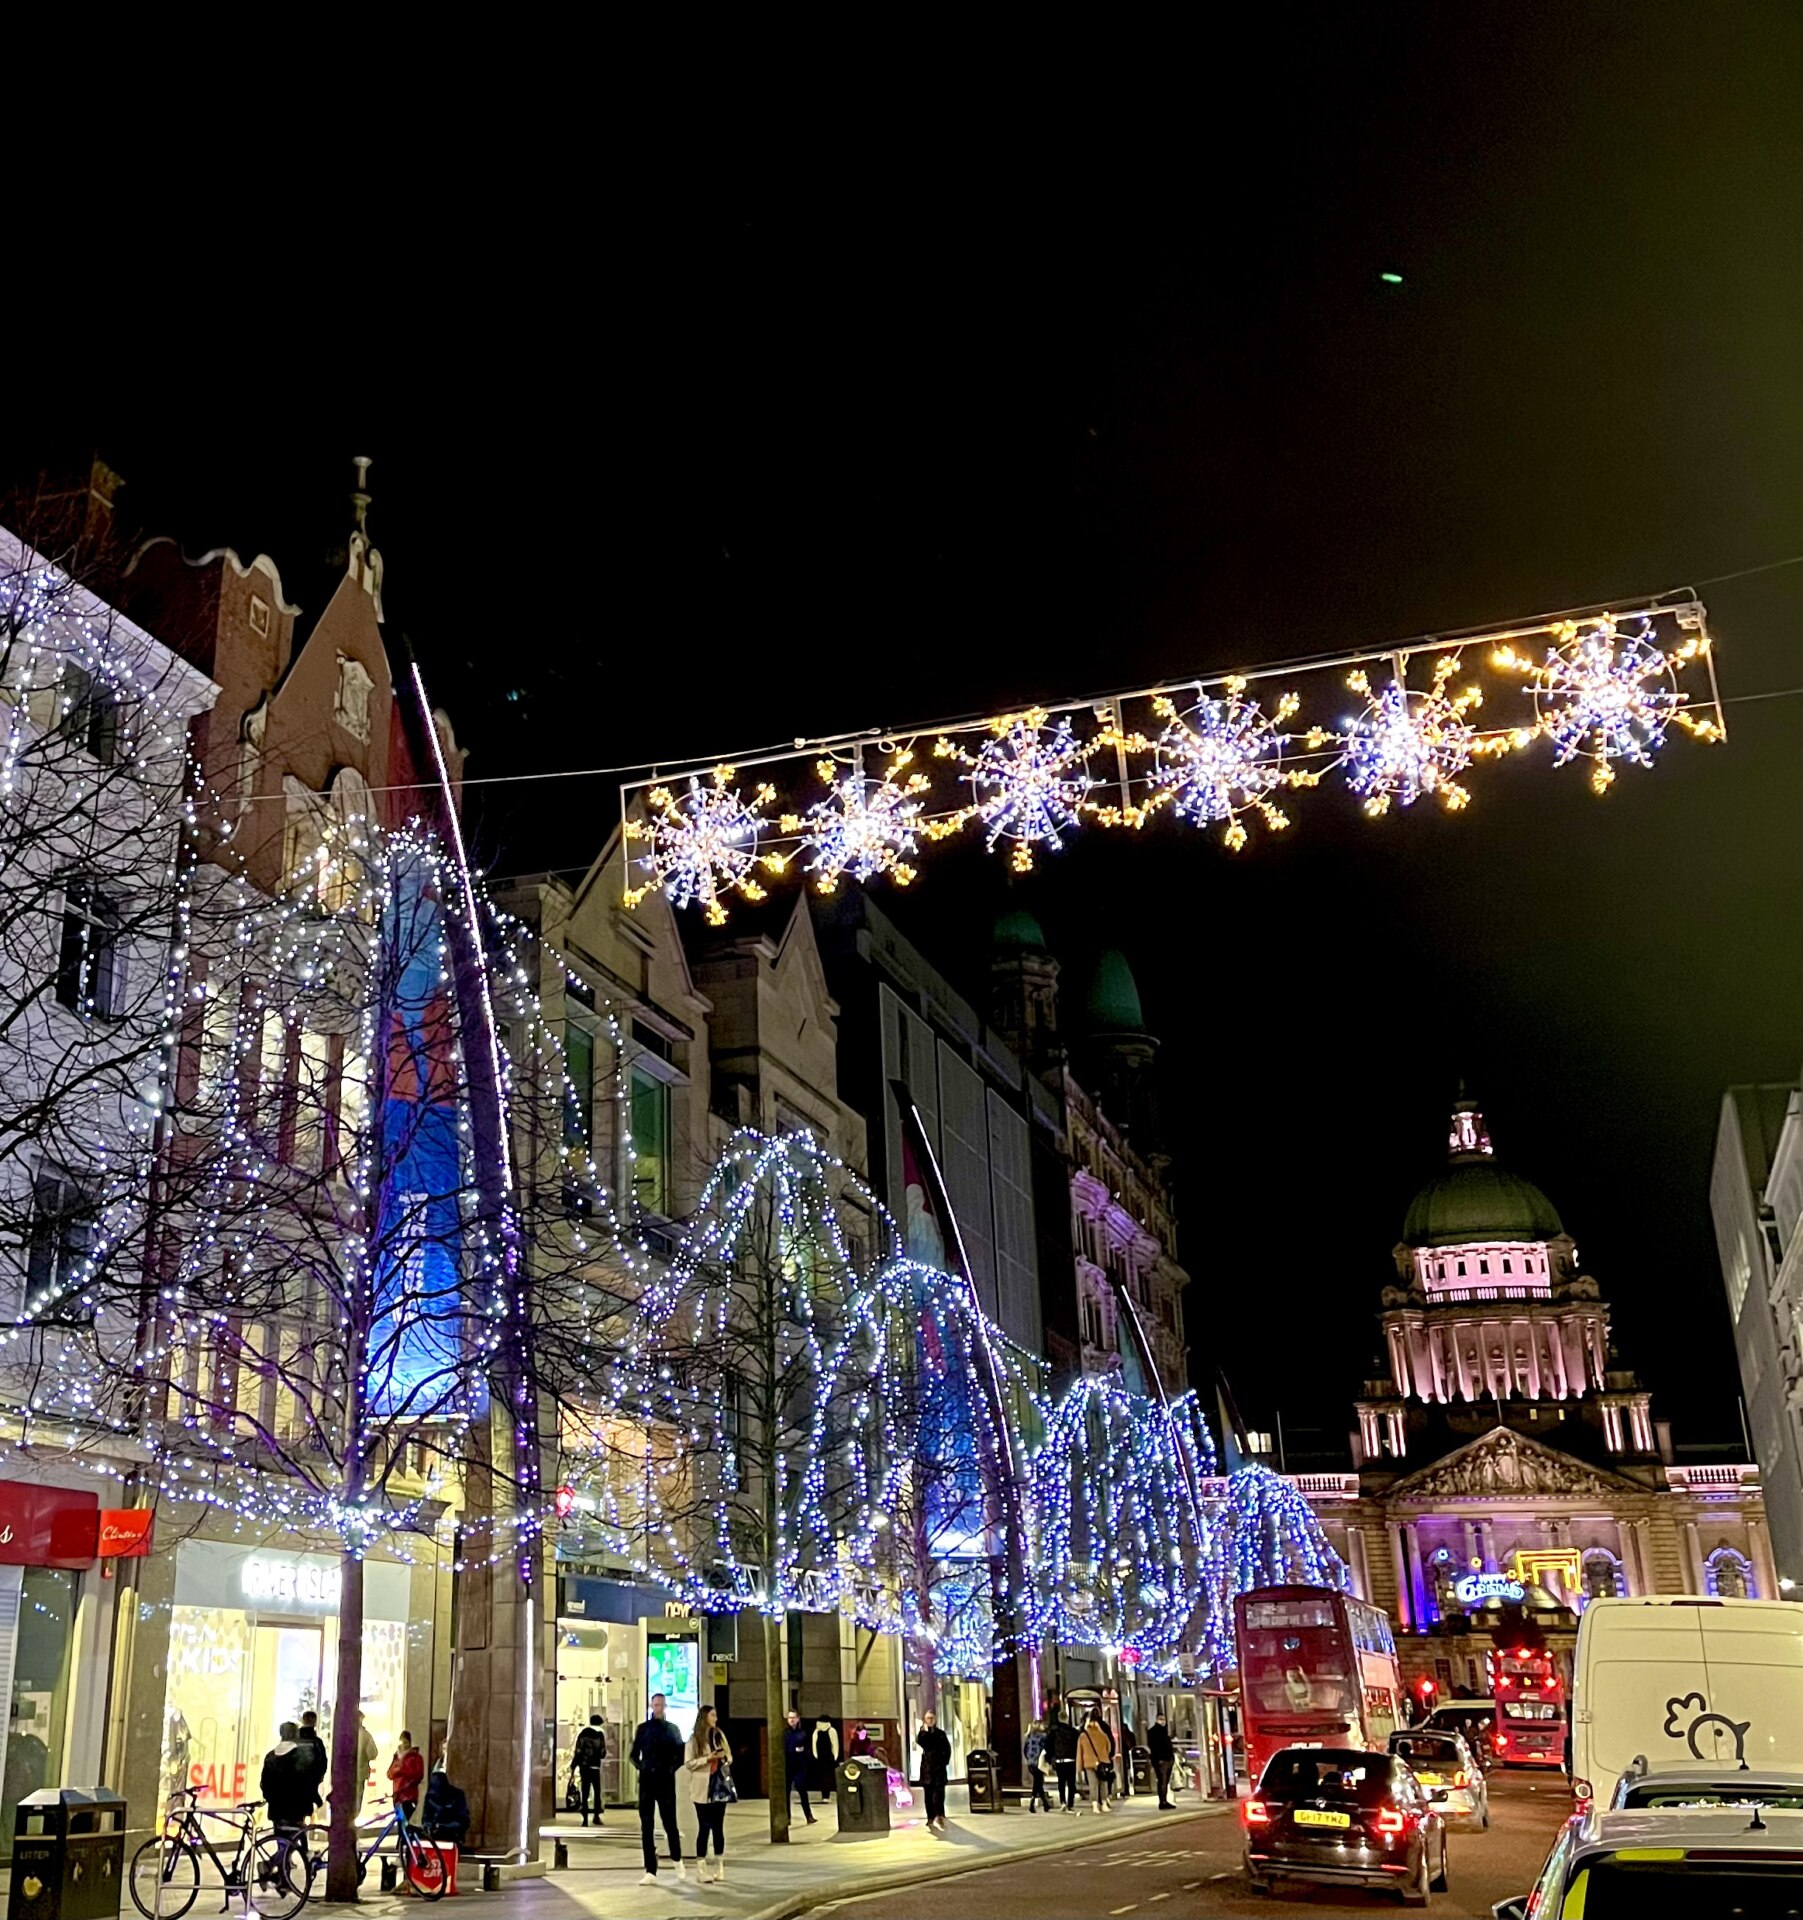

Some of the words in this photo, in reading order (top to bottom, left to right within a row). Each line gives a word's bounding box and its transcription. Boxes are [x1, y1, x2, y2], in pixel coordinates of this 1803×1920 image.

[298, 1563, 341, 1600] ISLA
[711, 1653, 734, 1662] next
[190, 1764, 246, 1799] SALE
